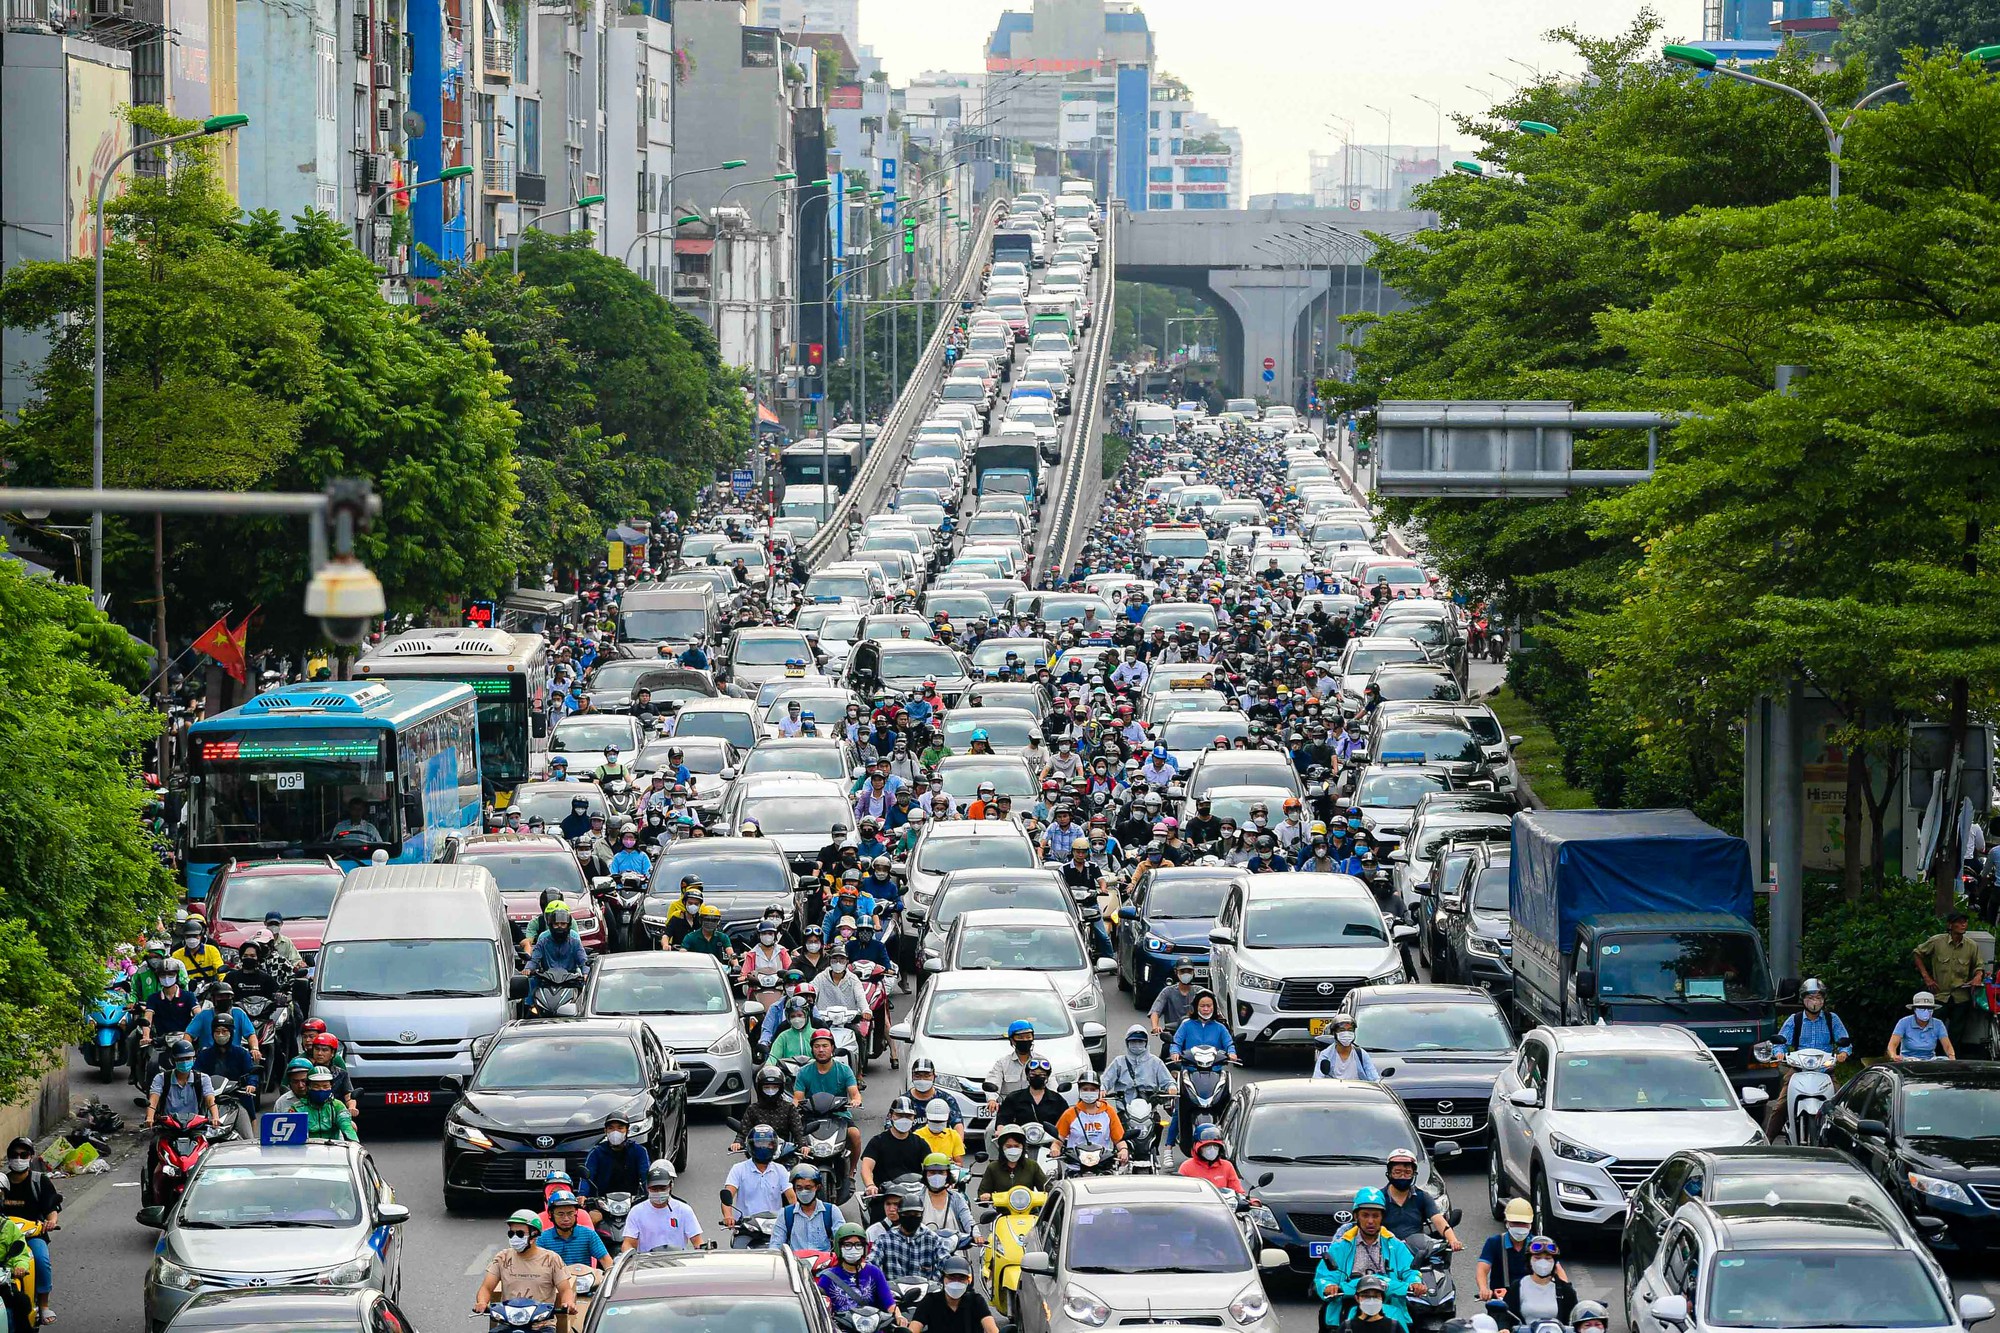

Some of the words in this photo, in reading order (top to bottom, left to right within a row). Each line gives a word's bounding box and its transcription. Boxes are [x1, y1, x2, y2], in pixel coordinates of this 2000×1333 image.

[387, 1092, 429, 1103] TT-23-03
[1420, 1117, 1472, 1128] 30F-398.32
[271, 1117, 297, 1142] G7
[537, 1160, 554, 1169] 51K
[1315, 1245, 1330, 1255] 80
